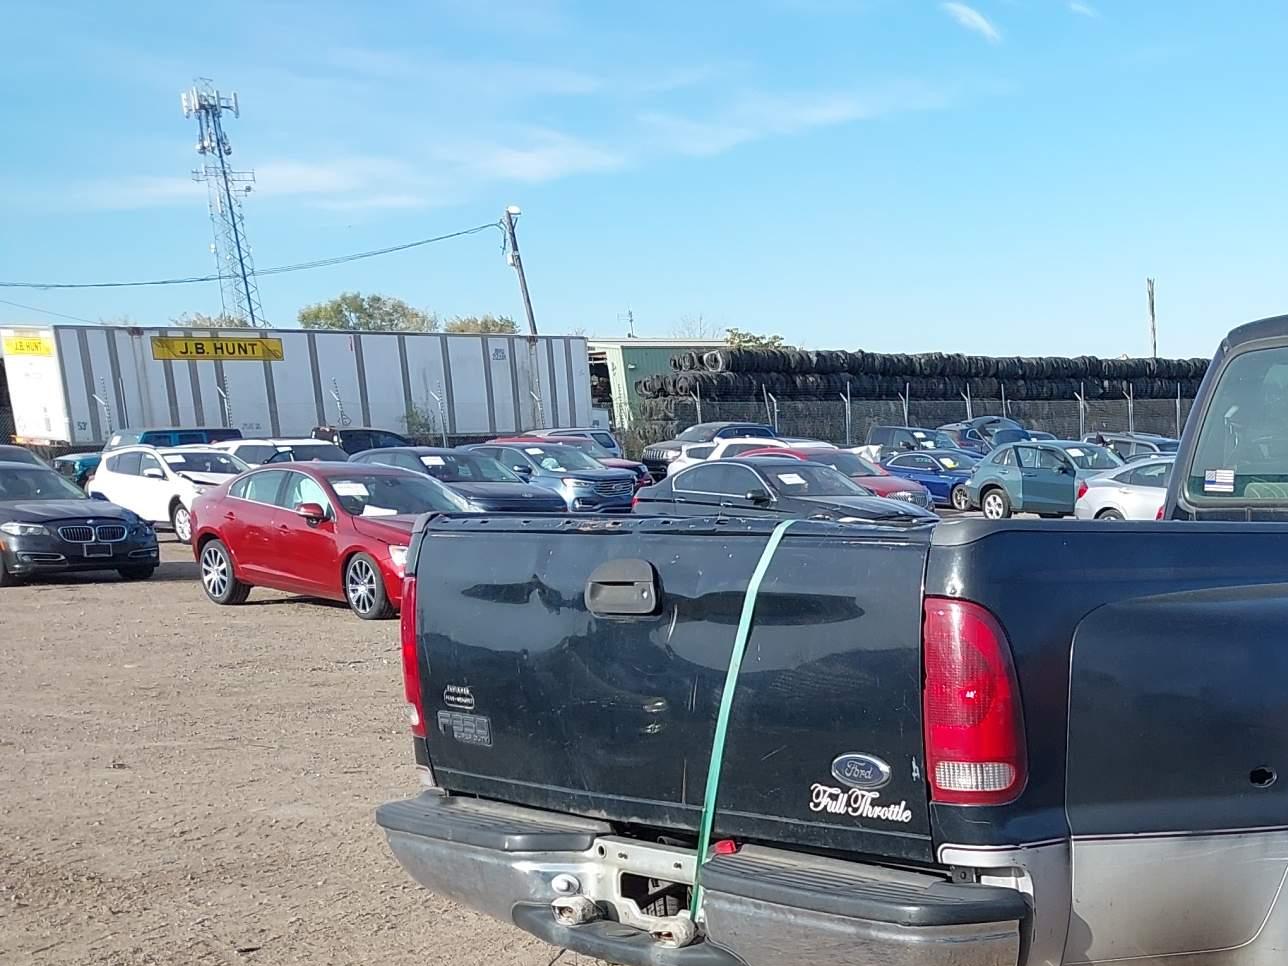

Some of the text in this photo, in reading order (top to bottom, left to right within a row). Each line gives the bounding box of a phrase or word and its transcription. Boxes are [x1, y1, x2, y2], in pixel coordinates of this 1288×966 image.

[180, 342, 257, 355] J.B. HUNT
[844, 760, 874, 779] Ford
[809, 783, 912, 823] Full Throttle
